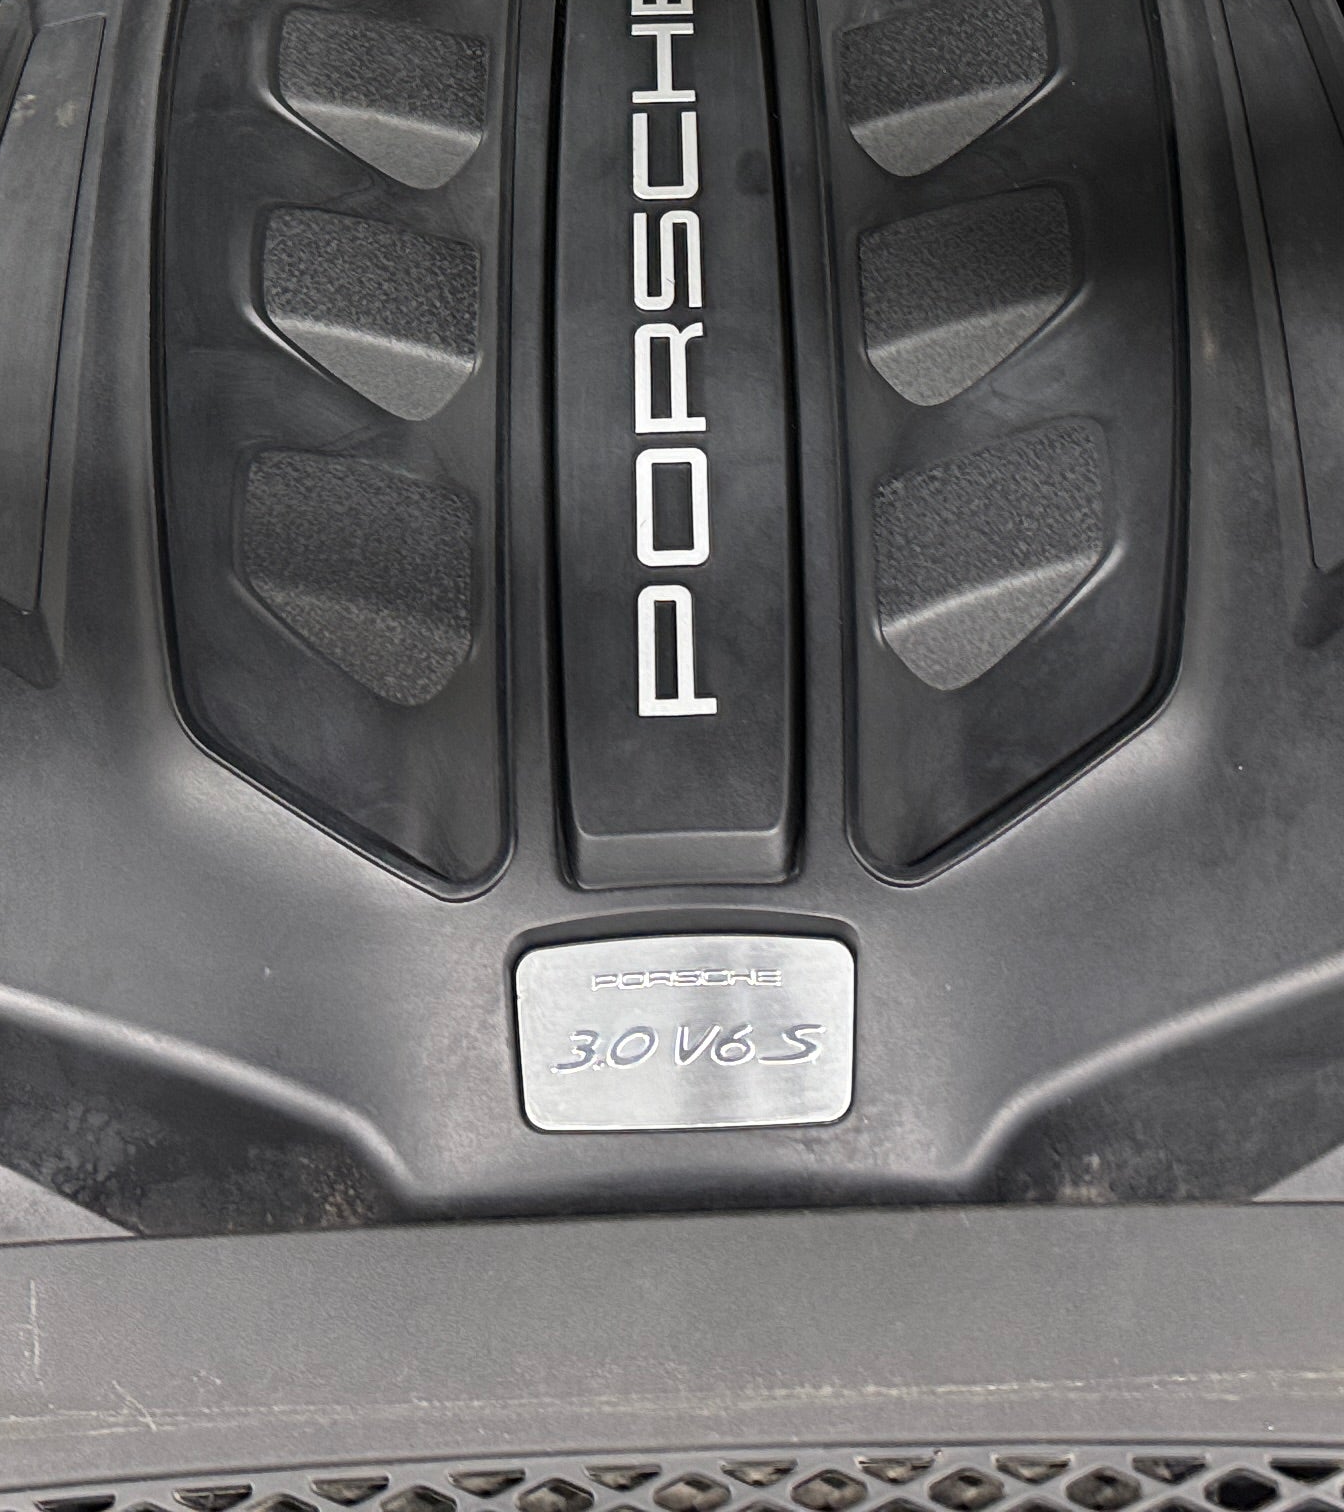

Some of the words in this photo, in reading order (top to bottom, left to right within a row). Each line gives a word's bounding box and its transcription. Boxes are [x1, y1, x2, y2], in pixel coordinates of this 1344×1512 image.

[591, 968, 783, 991] PORSCHE
[550, 1025, 659, 1075] 3.0
[674, 1023, 756, 1067] V6
[757, 1023, 826, 1066] S
